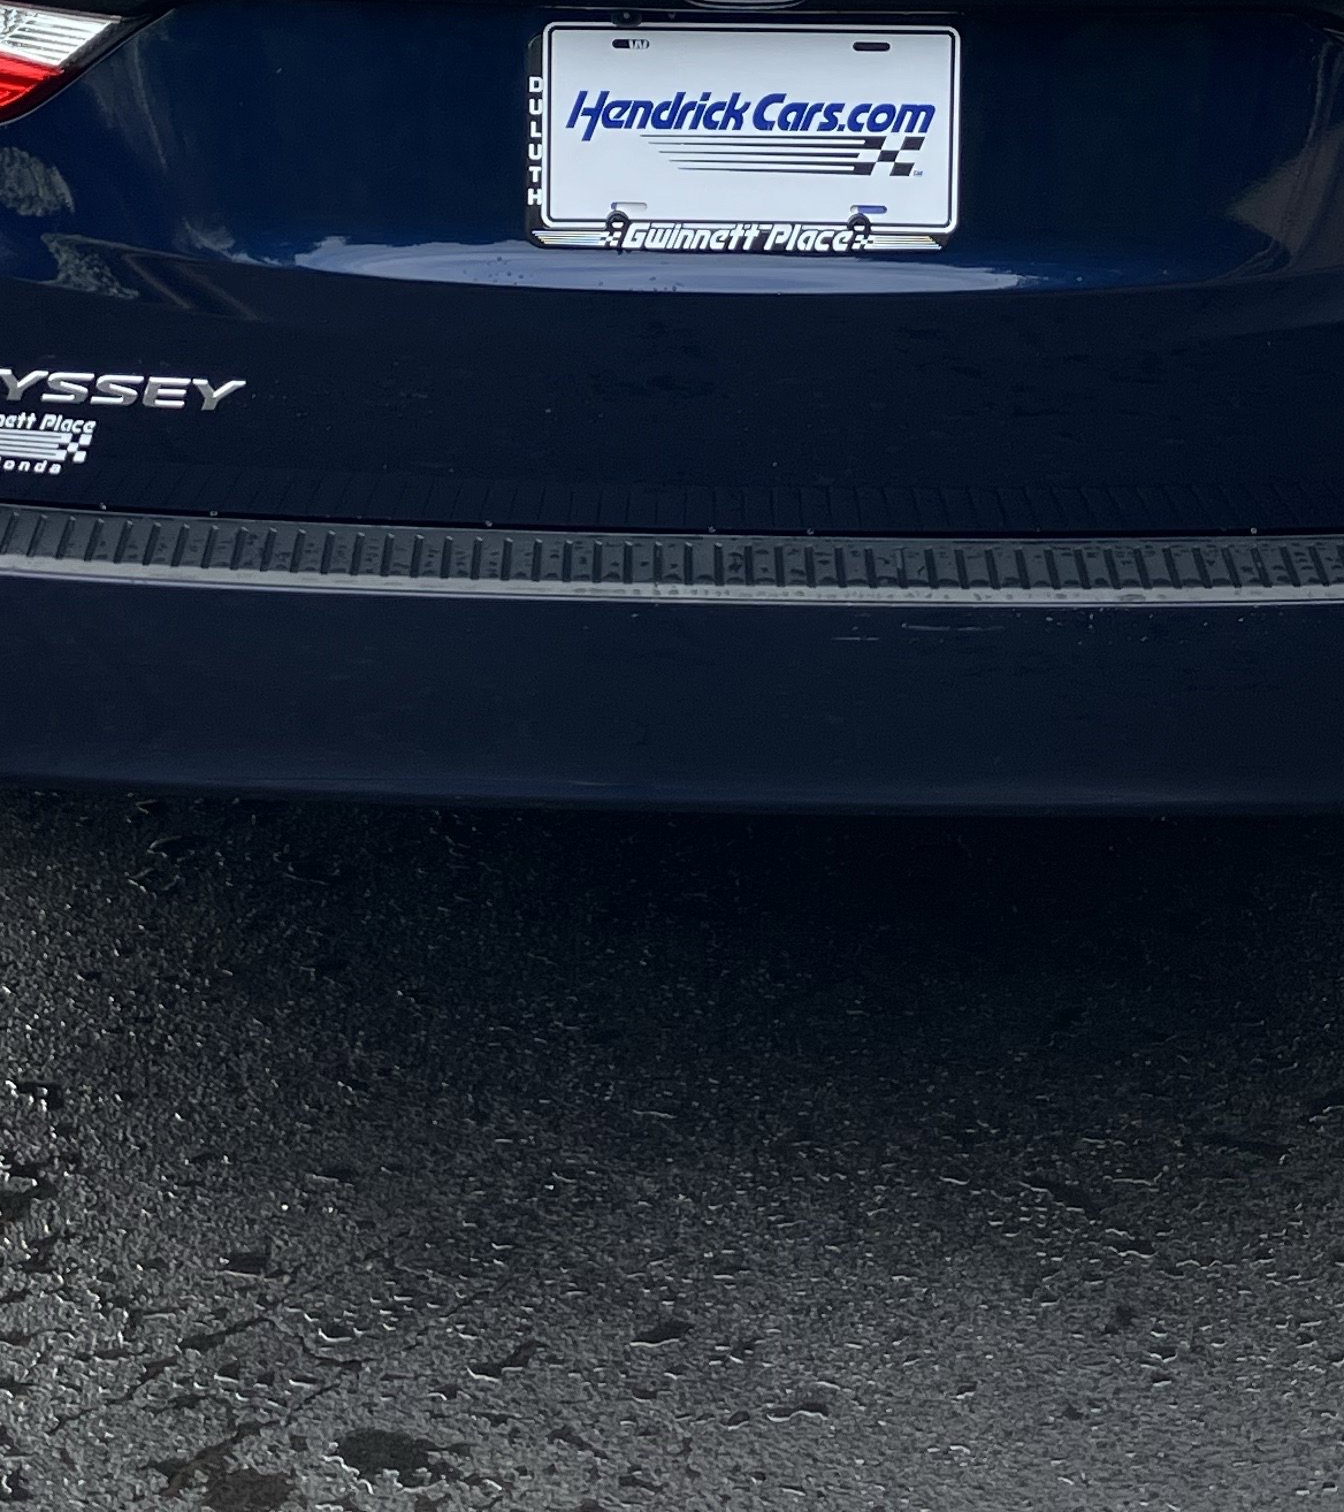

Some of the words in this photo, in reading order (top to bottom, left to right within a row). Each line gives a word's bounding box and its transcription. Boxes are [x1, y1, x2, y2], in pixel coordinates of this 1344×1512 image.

[528, 76, 543, 205] DULUTH
[621, 222, 760, 251] Gwinnett
[763, 223, 854, 252] Place
[39, 413, 96, 434] Place
